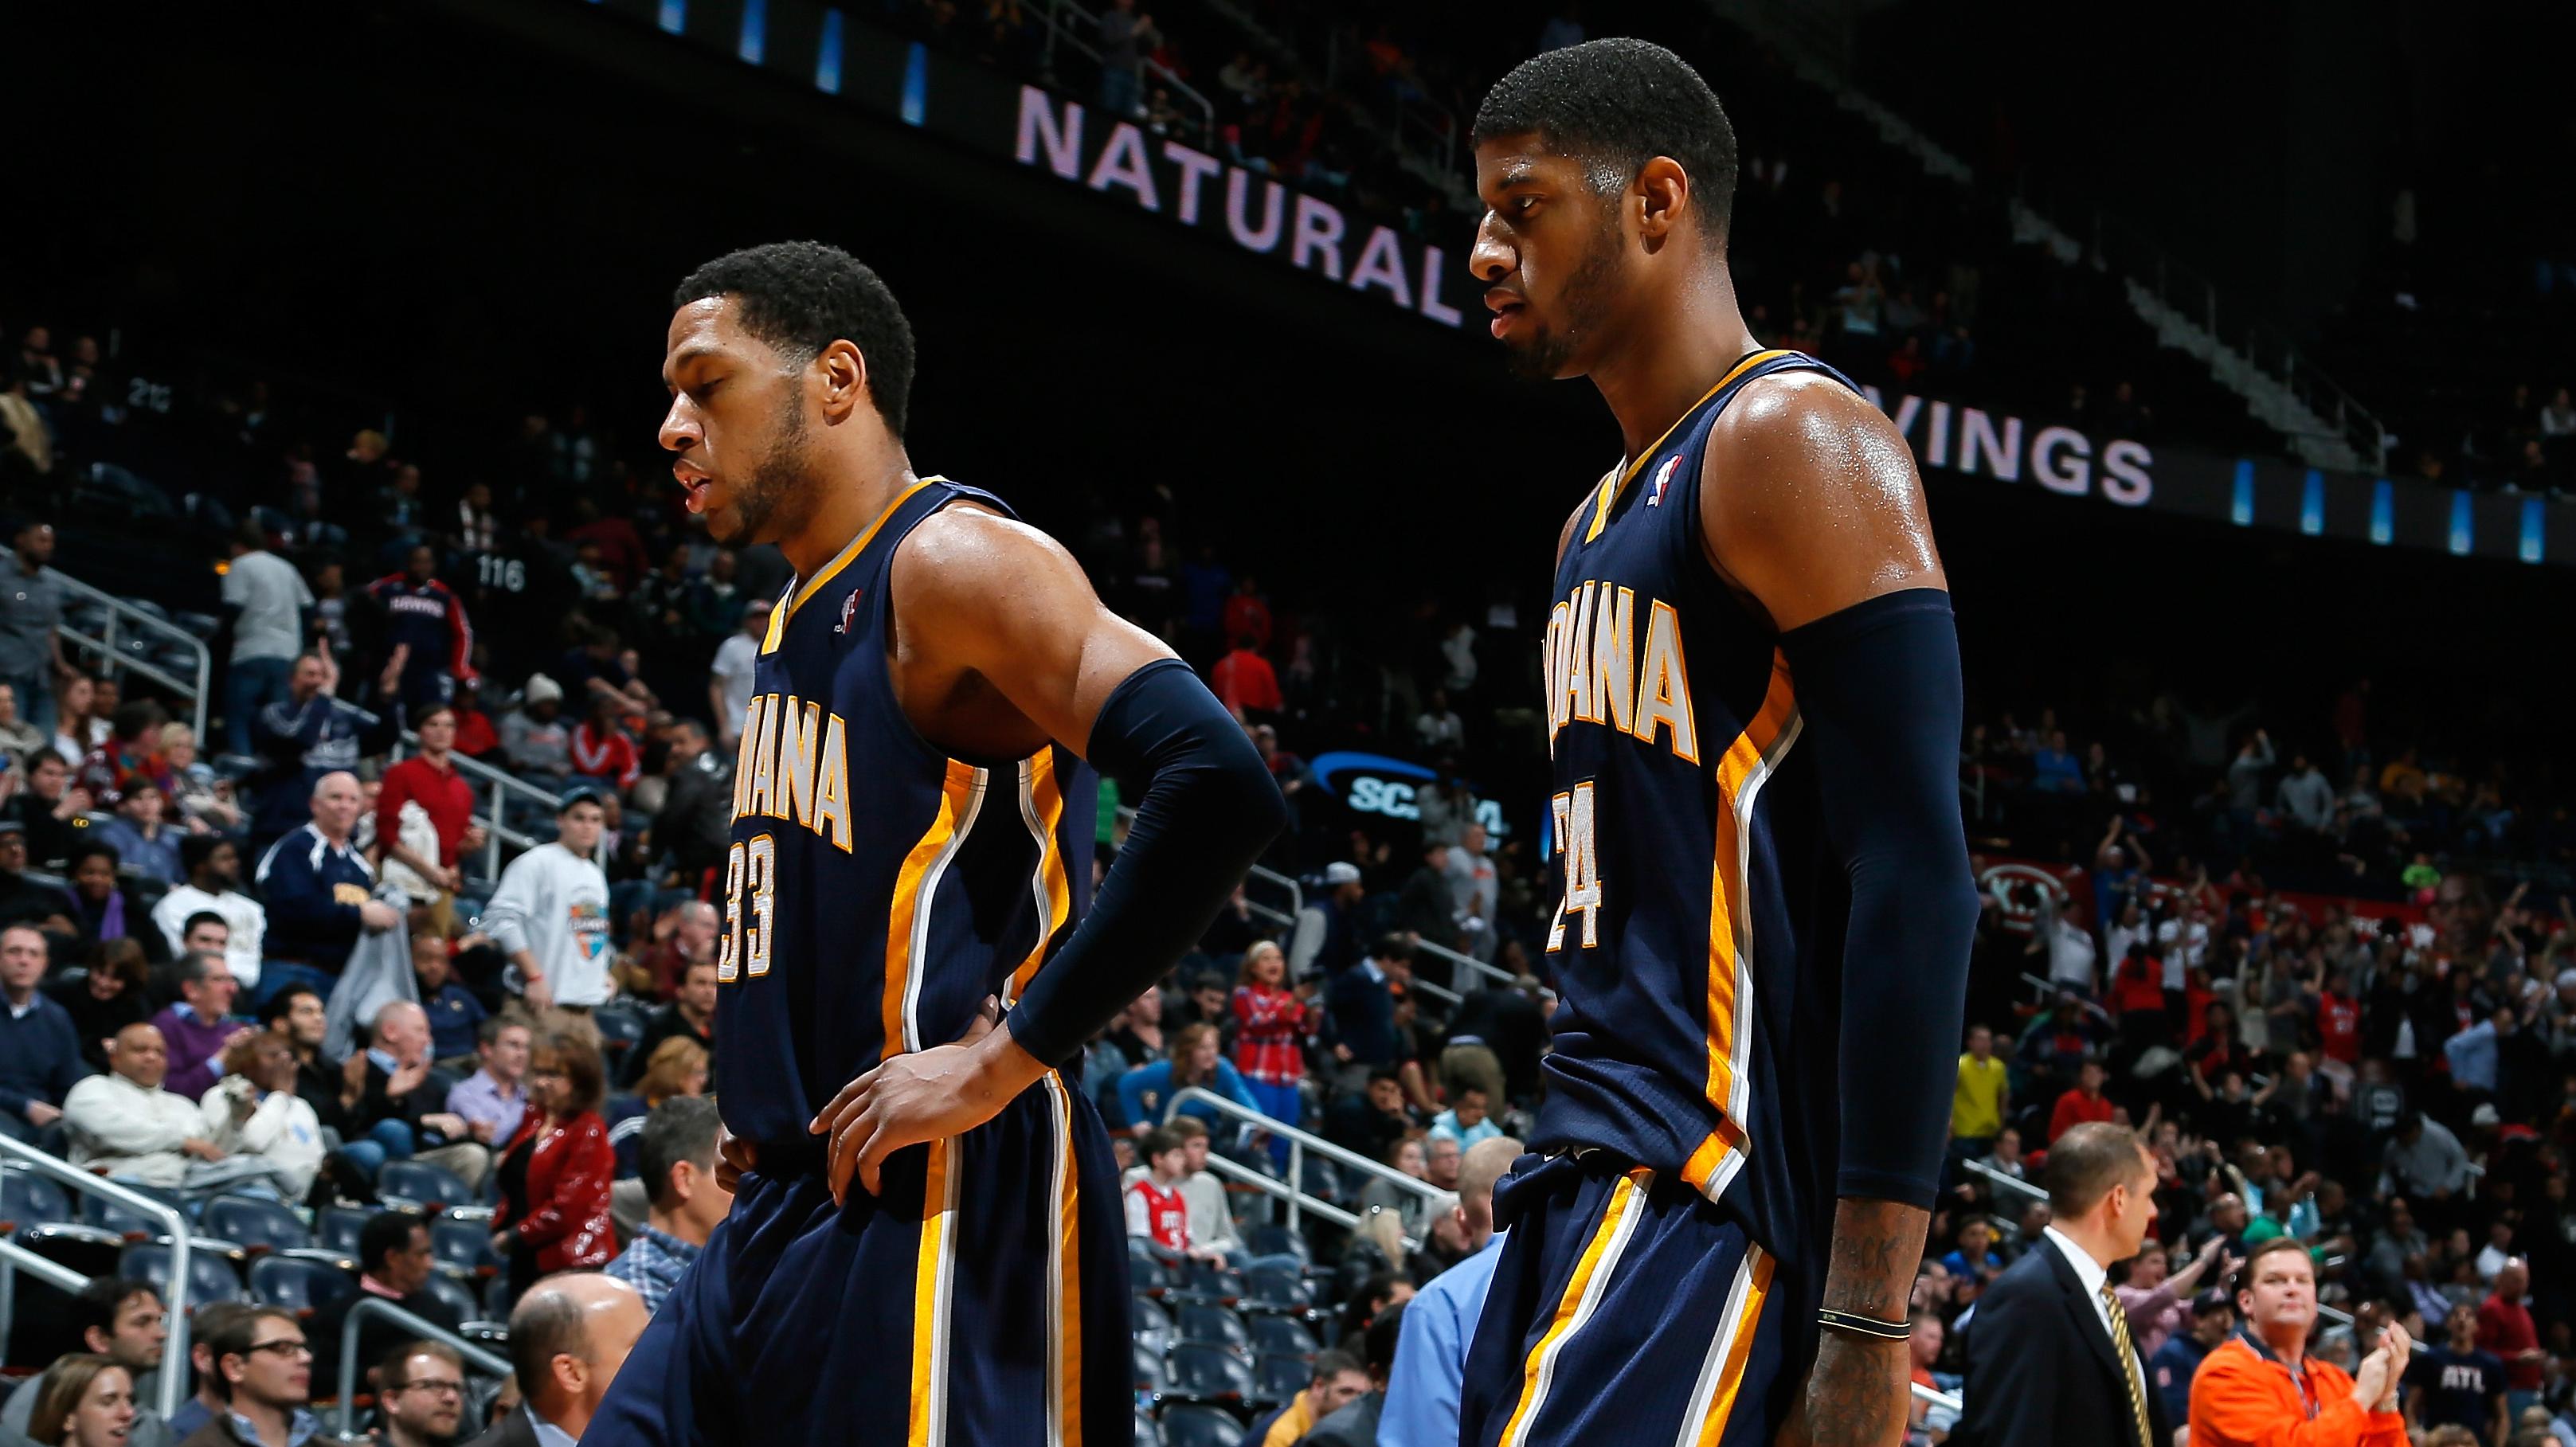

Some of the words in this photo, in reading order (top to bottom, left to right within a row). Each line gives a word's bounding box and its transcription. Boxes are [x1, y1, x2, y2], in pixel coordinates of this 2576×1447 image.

[1016, 84, 1463, 329] NATURAL
[477, 553, 527, 593] 116
[718, 833, 775, 983] 33
[1546, 780, 1601, 952] 24
[2441, 1364, 2486, 1394] ATL
